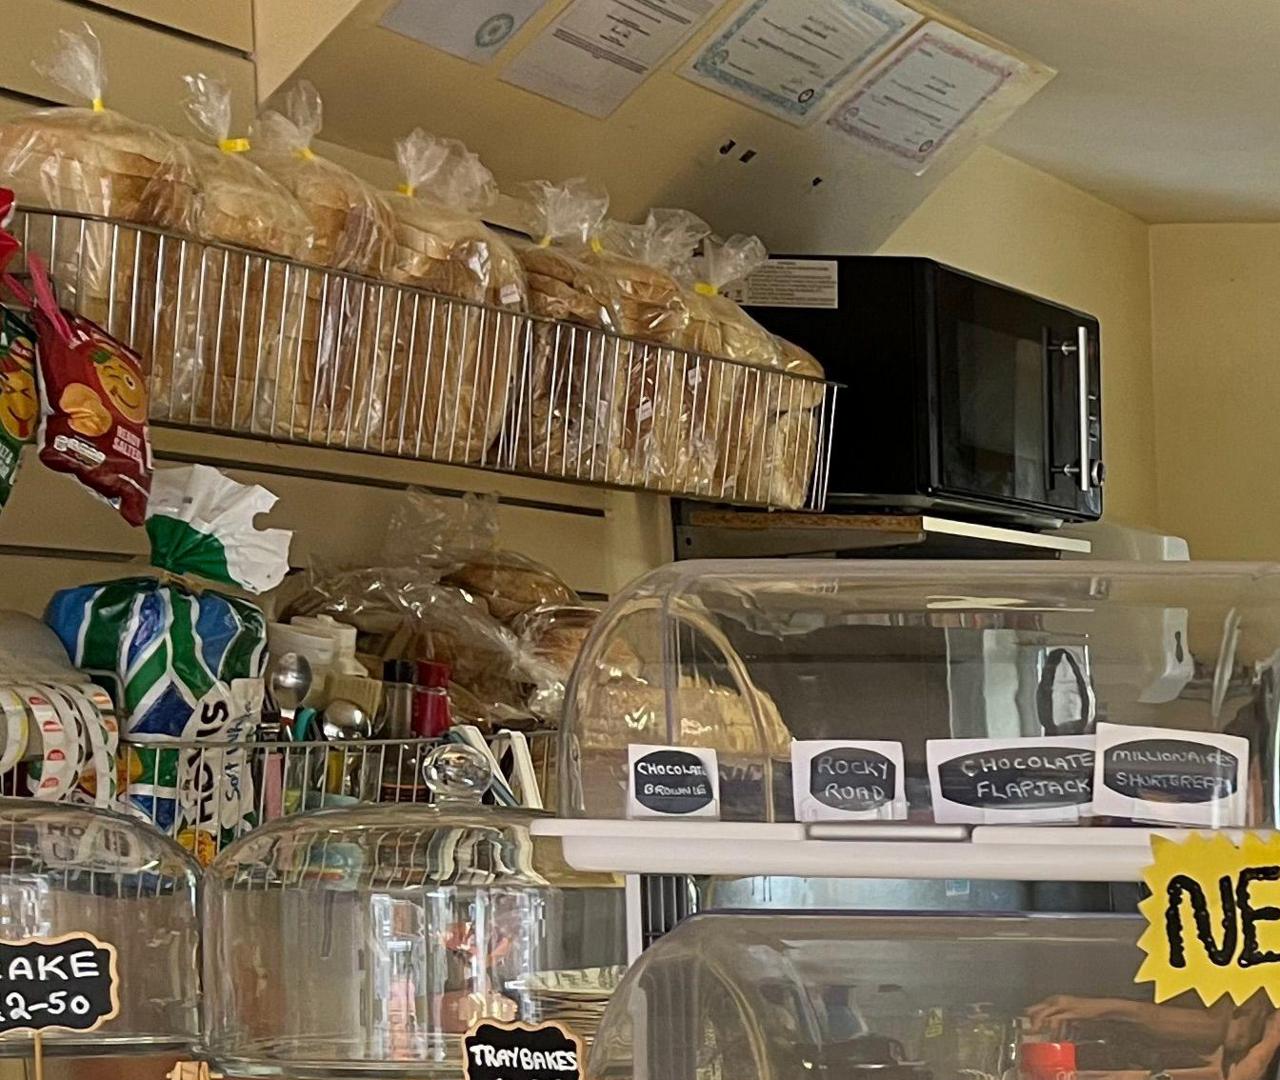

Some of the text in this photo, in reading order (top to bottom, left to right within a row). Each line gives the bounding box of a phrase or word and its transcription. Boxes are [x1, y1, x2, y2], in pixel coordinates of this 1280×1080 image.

[181, 700, 229, 826] HOVIS
[817, 756, 889, 780] ROCKY
[961, 752, 1094, 777] CHOCOLATE
[644, 784, 707, 797] BROWNIE
[825, 783, 886, 801] ROAD
[977, 778, 1092, 799] FLAPJACK
[0, 951, 99, 980] AKE
